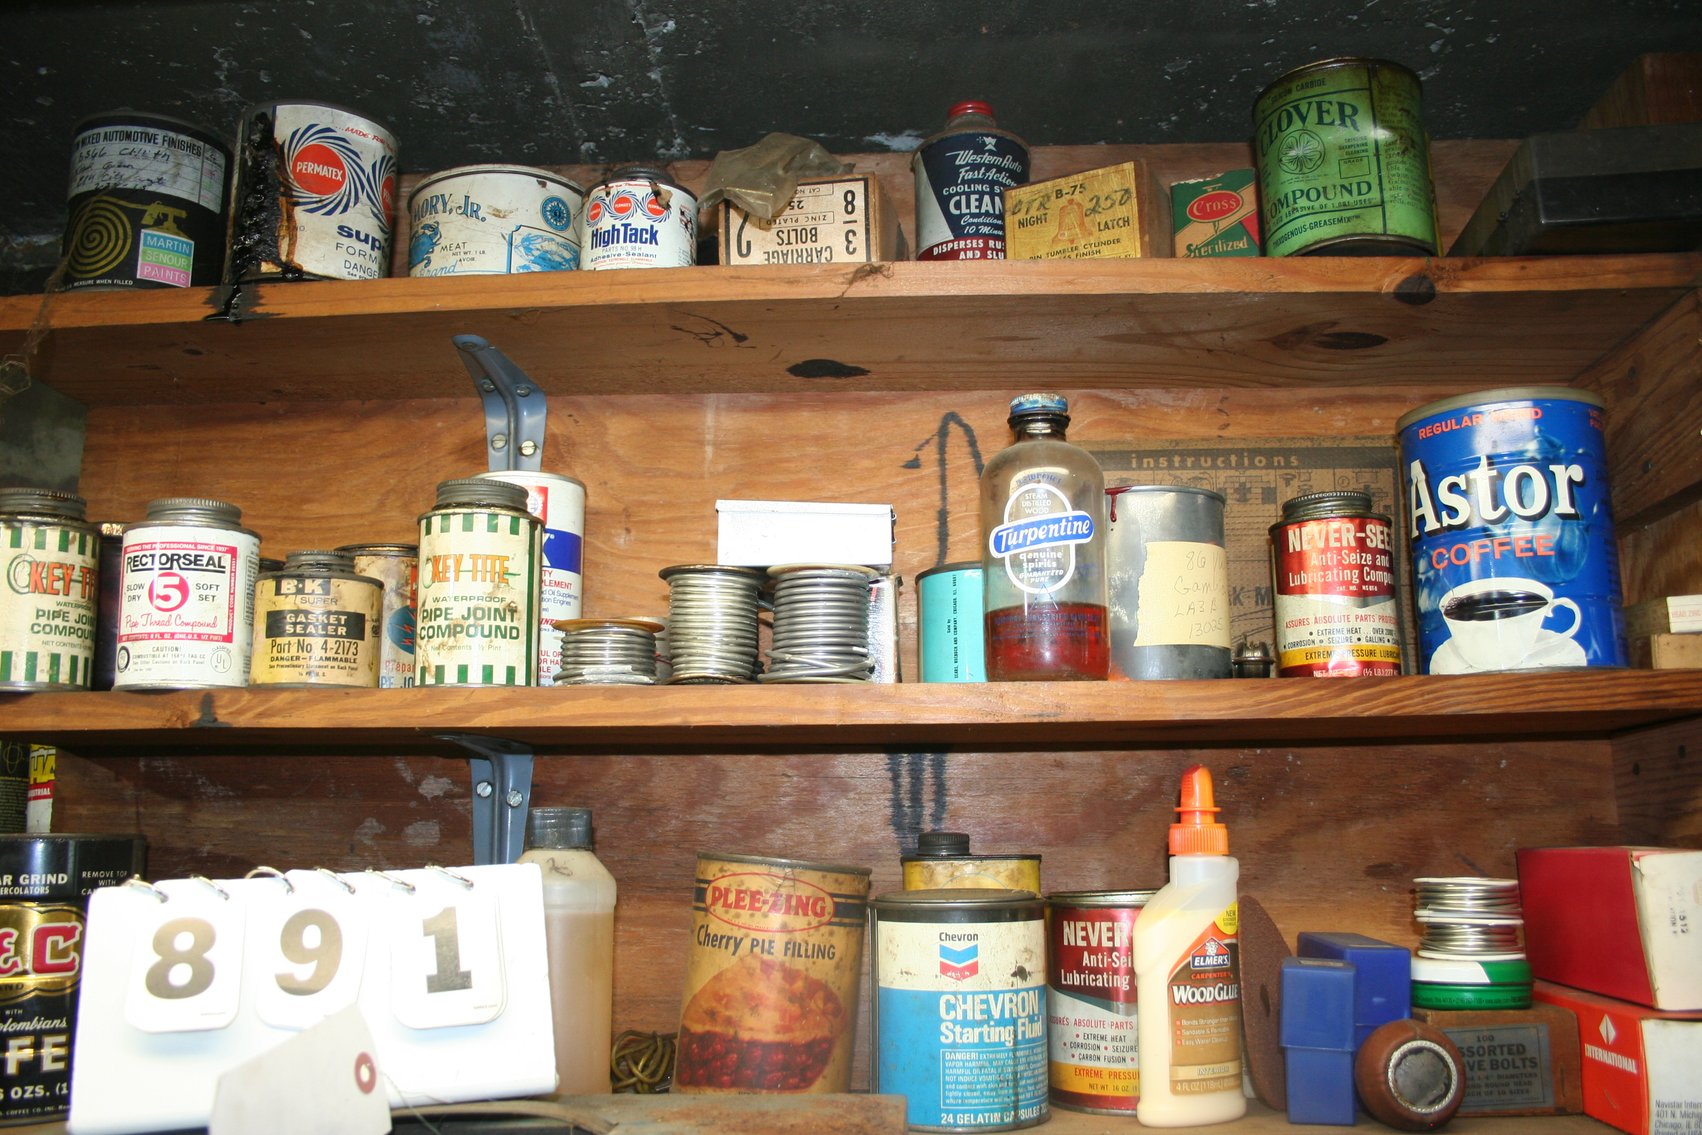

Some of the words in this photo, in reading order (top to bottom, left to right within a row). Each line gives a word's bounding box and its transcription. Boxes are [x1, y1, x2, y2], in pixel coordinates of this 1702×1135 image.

[1295, 78, 1327, 92] CARBIDE
[1260, 100, 1360, 158] CLOVER
[81, 133, 101, 147] MIXED
[102, 130, 159, 146] AUTOMOTIVE
[162, 136, 202, 157] FINISHES
[945, 150, 1002, 166] Western
[1001, 154, 1023, 173] Auto
[296, 161, 344, 182] PERMATEX
[957, 166, 986, 185] Fast
[983, 167, 1018, 187] Action
[942, 184, 990, 196] COOLING
[1055, 182, 1087, 200] B-75
[788, 199, 805, 211] 25
[1192, 197, 1238, 217] Cross
[1265, 180, 1373, 226] COMPOUND
[766, 216, 800, 226] PLATED
[804, 214, 828, 222] ZINC
[1018, 212, 1049, 229] NIGHT
[1097, 216, 1130, 232] LATCH
[776, 227, 818, 247] BOLTS
[964, 226, 976, 234] 10
[147, 236, 191, 255] MARTIN
[440, 242, 468, 253] MEAT
[933, 239, 984, 256] DISPERSES
[1046, 246, 1079, 259] TUMBLER
[1083, 238, 1121, 250] CYLINDER
[1185, 236, 1249, 259] Sterilized
[145, 250, 188, 267] SENOUR
[762, 245, 834, 265] CARRIAGE
[959, 250, 981, 260] AND
[1075, 250, 1101, 259] FINISH
[143, 266, 187, 284] PAINTS
[1418, 413, 1483, 440] REGULAR
[1130, 452, 1299, 468] instructions
[1409, 454, 1585, 540] Astor
[998, 515, 1091, 554] Turpentine
[1287, 522, 1393, 553] NEVER-SEE
[142, 543, 153, 551] THE
[153, 542, 196, 550] PROFESSIONAL
[196, 543, 215, 551] SINCE
[1019, 548, 1063, 561] genuine
[1431, 534, 1556, 571] COFFEE
[126, 552, 227, 574] RECTORSEAL
[1022, 559, 1057, 572] spirits
[1311, 549, 1372, 566] Anti-Seize
[1375, 553, 1390, 567] and
[431, 554, 465, 584] KEY
[469, 554, 510, 585] TITE
[1289, 567, 1360, 587] Lubricating
[28, 560, 76, 597] KEY
[126, 582, 146, 592] SLOW
[195, 582, 221, 592] SOFT
[155, 575, 183, 610] 5
[127, 594, 142, 603] DRY
[198, 594, 218, 603] SET
[300, 596, 338, 606] SUPER
[432, 595, 507, 604] WATERPROOF
[35, 607, 70, 623] PIPE
[125, 614, 140, 632] Pipe
[141, 612, 173, 628] Thread
[174, 613, 218, 633] Compound
[286, 613, 348, 625] GASKET
[421, 607, 454, 623] PIPE
[461, 606, 518, 624] JOINT
[1285, 617, 1310, 629] ASSURES
[1313, 614, 1352, 625] ABSOLUTE
[1354, 614, 1376, 623] PARTS
[285, 625, 347, 636] SEALER
[419, 624, 520, 641] COMPOUND
[1316, 628, 1345, 637] EXTREME
[1346, 627, 1362, 635] HEAT
[270, 639, 291, 655] Part
[321, 641, 359, 656] 4-2173
[1287, 638, 1316, 649] CORROSION
[1327, 636, 1354, 644] SEIZURE
[308, 656, 358, 664] FLAMMABLE
[19, 873, 69, 886] GRIND
[82, 870, 114, 878] REMOVE
[116, 870, 128, 878] TOP
[710, 886, 827, 919] PLEE-ZING
[697, 924, 744, 957] Cherry
[750, 938, 775, 956] PIE
[783, 941, 836, 961] FILLING
[938, 931, 979, 942] Chevron
[1194, 954, 1229, 966] ELMER'S
[1061, 968, 1131, 991] Lubricating
[939, 990, 1039, 1022] CHEVRON
[940, 1020, 1014, 1047] Starting
[1017, 1016, 1043, 1041] Fluid
[1073, 1018, 1107, 1030] ABSOLUTE
[1110, 1020, 1134, 1030] PARTS
[1082, 1032, 1108, 1043] EXTREME
[1110, 1034, 1127, 1044] HEAT
[1476, 1034, 1495, 1042] 100
[1069, 1041, 1101, 1051] CORROSION
[1111, 1044, 1138, 1053] SEIZURE
[945, 1052, 979, 1060] DANGER!
[1078, 1053, 1101, 1062] CARBON
[1103, 1054, 1127, 1064] FUSION
[1489, 1056, 1538, 1071] BOLTS
[1584, 1043, 1637, 1075] INTERNATIONAL
[1074, 1067, 1105, 1080] EXTREME
[11, 1084, 51, 1100] OZS.
[1655, 1099, 1683, 1108] Navistar
[941, 1112, 954, 1124] 24
[956, 1112, 1001, 1125] GELATIN
